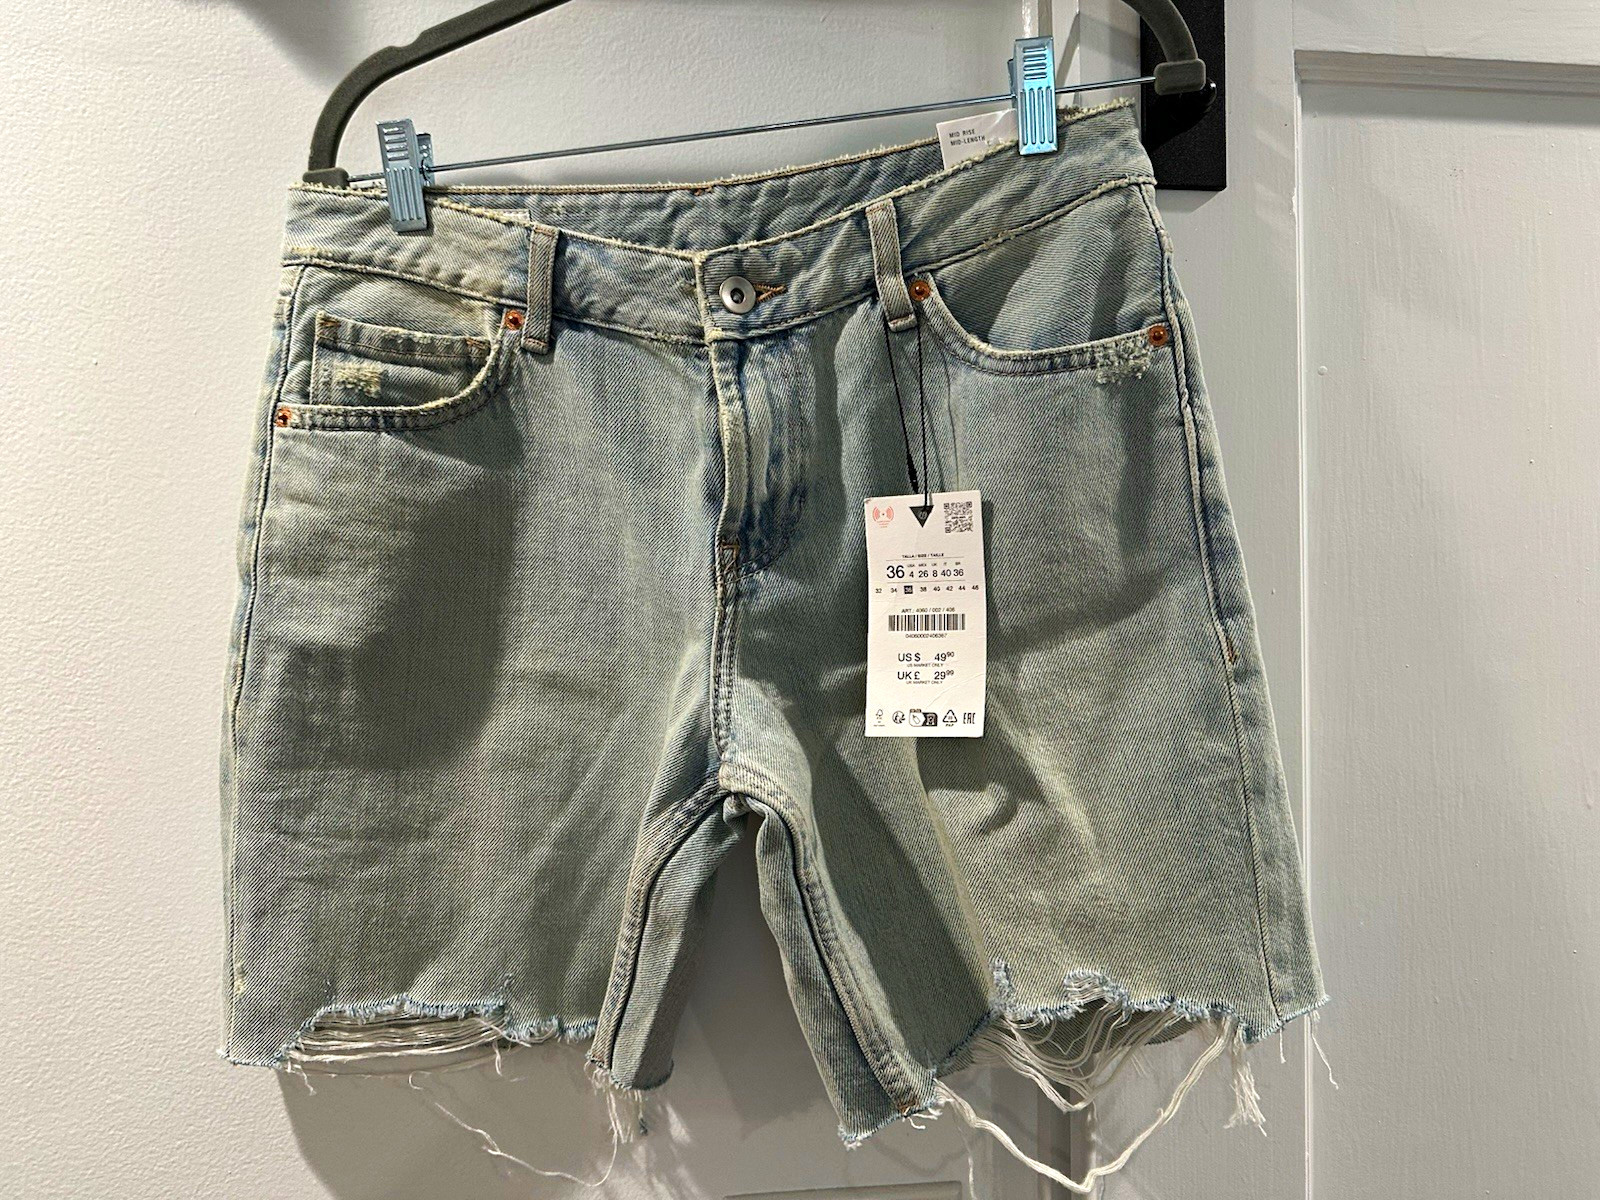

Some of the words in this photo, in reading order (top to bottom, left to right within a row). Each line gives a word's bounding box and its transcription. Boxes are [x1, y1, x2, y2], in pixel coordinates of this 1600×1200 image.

[962, 128, 975, 136] RISE
[950, 135, 986, 146] MID-LENGTH
[886, 565, 905, 579] 36
[918, 570, 928, 578] 26
[932, 569, 938, 577] 8
[941, 569, 951, 577] 40
[953, 568, 964, 577] 36
[898, 653, 912, 662] US
[914, 652, 921, 662] $
[897, 671, 912, 680] UK
[914, 671, 920, 680] £
